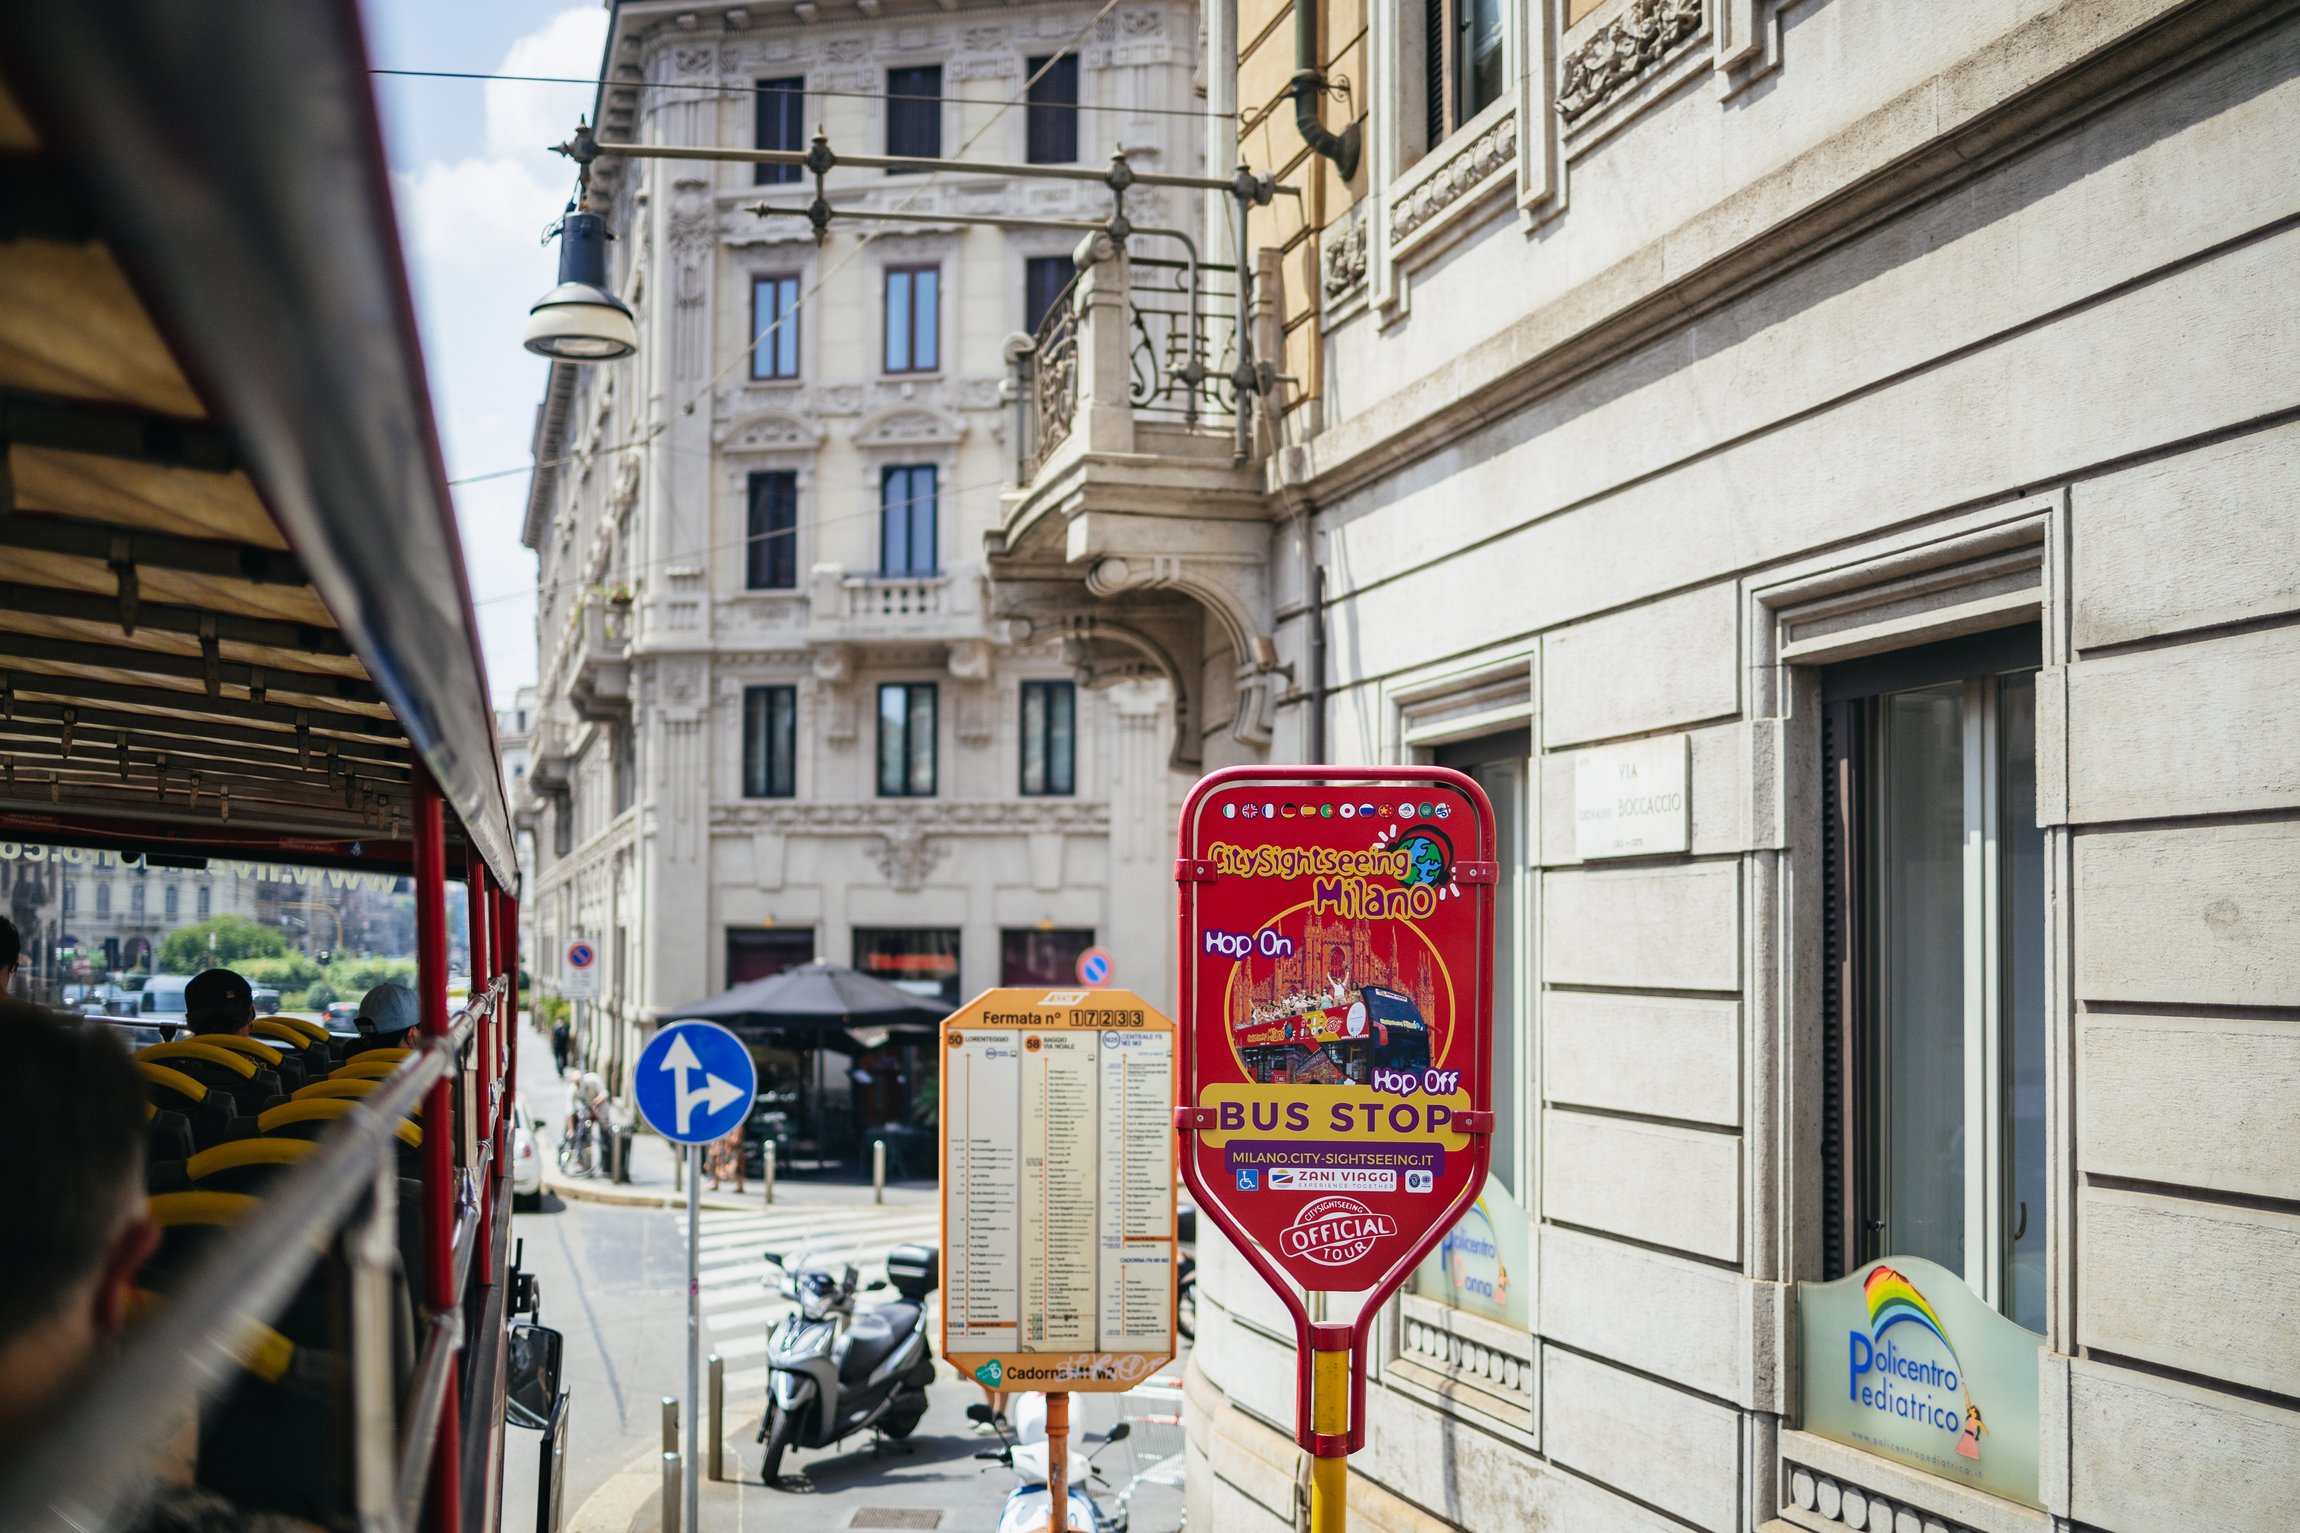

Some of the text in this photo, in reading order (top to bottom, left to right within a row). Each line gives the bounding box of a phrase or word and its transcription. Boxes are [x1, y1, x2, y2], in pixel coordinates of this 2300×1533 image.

[1619, 763, 1637, 779] VIA
[1618, 793, 1681, 817] BOCCACCIO
[1209, 842, 1411, 879] CitySightseeing
[1314, 877, 1435, 919] Milano
[1205, 930, 1292, 957] Hop On
[983, 1011, 1041, 1025] Fermata
[1045, 1012, 1061, 1025] n°
[948, 1034, 963, 1045] 50
[1025, 1038, 1041, 1048] 58
[1374, 1070, 1459, 1093] Hop Off
[1220, 1101, 1451, 1133] BUS STOP
[1233, 1152, 1434, 1167] MILANO.CITY-SIGHTSEEING.IT
[1298, 1170, 1394, 1183] ZANI VIAGGI
[1304, 1199, 1364, 1222] CITYSIGHTSEEING
[1291, 1217, 1390, 1250] OFFICIAL
[1323, 1241, 1367, 1261] TOUR
[1453, 1255, 1492, 1297] Donna
[1006, 1366, 1068, 1380] Cadorna
[1849, 1330, 1958, 1402] Policentro
